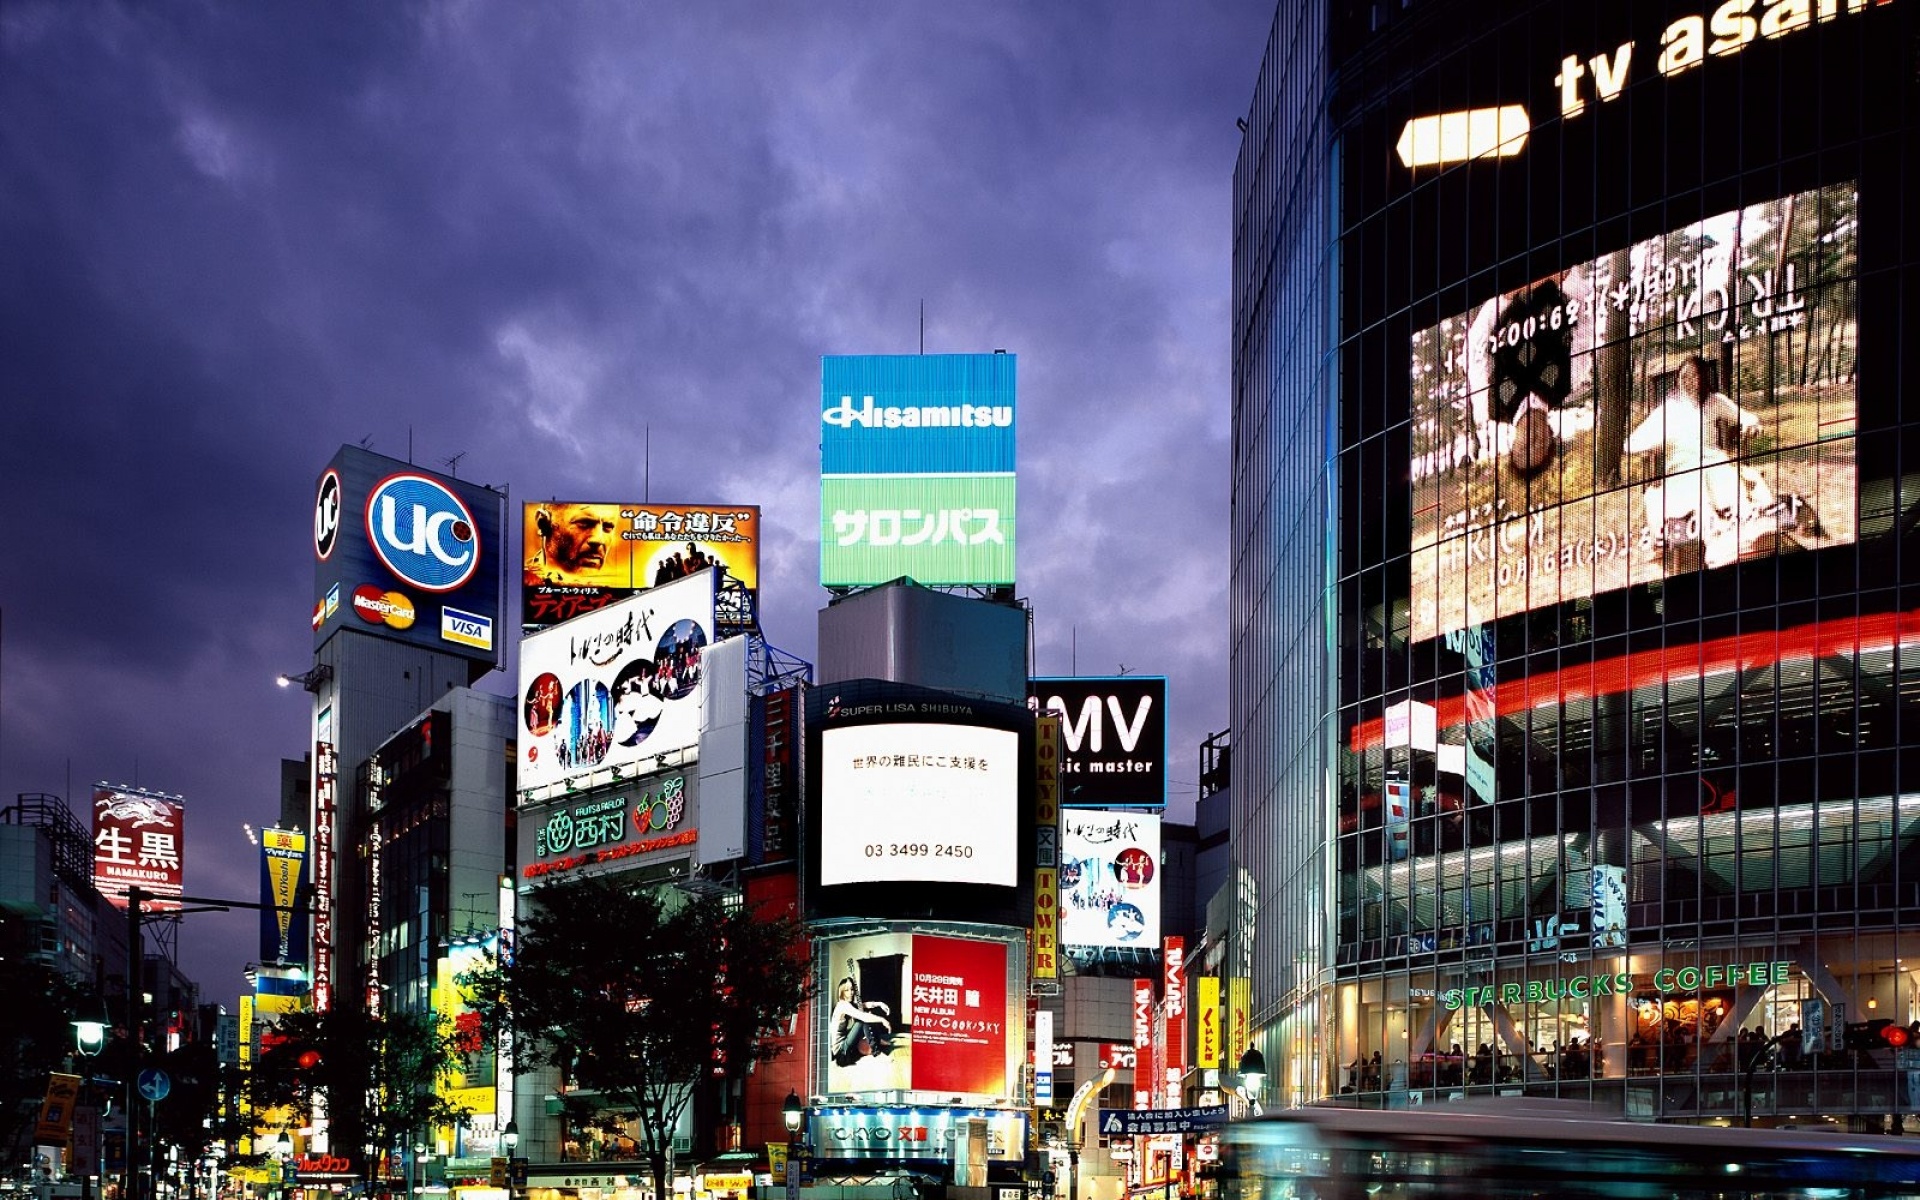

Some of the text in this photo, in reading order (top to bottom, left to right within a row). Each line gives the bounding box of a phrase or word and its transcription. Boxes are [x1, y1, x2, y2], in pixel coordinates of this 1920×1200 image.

[1554, 40, 1635, 120] tv
[822, 395, 1013, 429] Hisamitsu
[832, 508, 1004, 547] サロンパス
[354, 595, 415, 620] MasterCard
[450, 618, 482, 638] VISA
[841, 703, 973, 717] SUPER LISA SHIBUYA
[1028, 695, 1153, 752] MV
[1038, 724, 1055, 821] TOKYO
[1089, 759, 1153, 773] master
[575, 811, 625, 848] 西村
[95, 826, 179, 870] 生黒
[864, 844, 973, 858] 03 3499 2450
[106, 866, 168, 881] NAMAKURO
[1036, 873, 1054, 969] TOWER
[913, 985, 958, 1006] 矢井田
[1167, 947, 1183, 1019] さくらや
[1445, 972, 1633, 1010] STARBUCKS
[1654, 961, 1791, 993] COFFEE
[914, 1006, 955, 1016] NEW ALBUM
[1135, 988, 1150, 1049] さくらや
[829, 1127, 892, 1141] TOKYO
[898, 1127, 928, 1142] 文庫
[1127, 1121, 1191, 1133] 会員募集中
